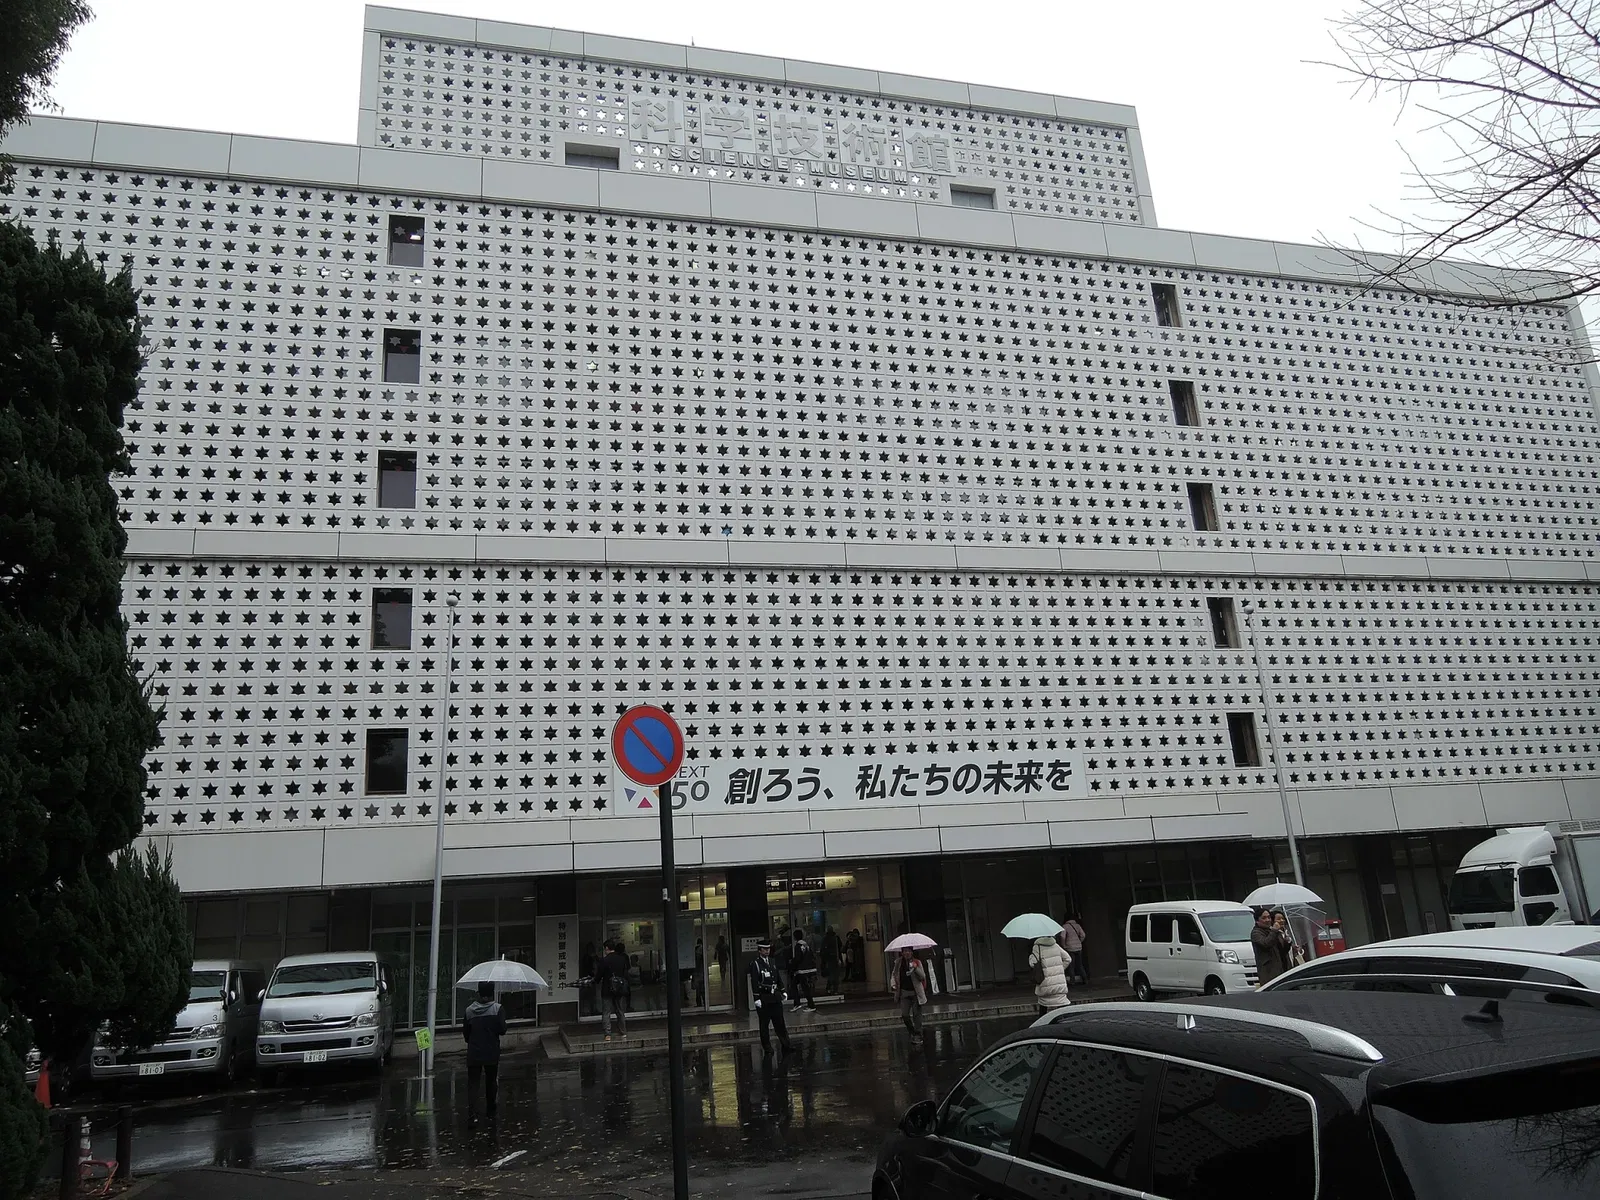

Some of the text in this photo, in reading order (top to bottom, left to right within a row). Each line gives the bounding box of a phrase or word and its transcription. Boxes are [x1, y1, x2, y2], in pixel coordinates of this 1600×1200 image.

[631, 99, 951, 172] 科学技術館
[669, 146, 908, 184] SCIENCE MUSEUM
[674, 765, 710, 778] EXT
[724, 759, 1072, 805] 創ろう、私たちの未来を
[671, 780, 710, 810] 50
